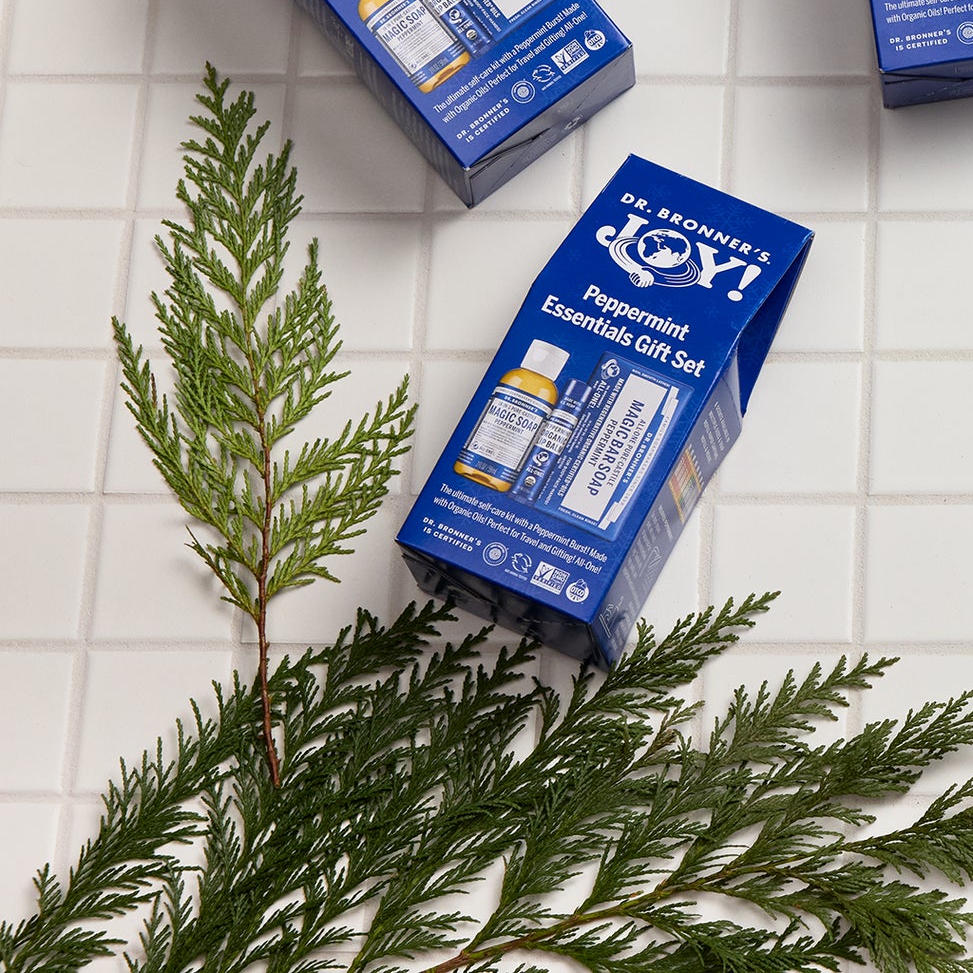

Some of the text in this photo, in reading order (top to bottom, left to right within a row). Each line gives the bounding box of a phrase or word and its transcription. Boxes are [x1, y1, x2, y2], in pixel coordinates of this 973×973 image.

[382, 5, 429, 42] MAGIC SOAP
[884, 2, 897, 10] The
[885, 13, 901, 23] with
[901, 10, 927, 22] Organic
[926, 7, 942, 17] Oils!
[942, 4, 967, 14] Perfect
[432, 102, 447, 112] The
[444, 84, 470, 105] ultimate
[467, 67, 493, 88] self-care
[489, 60, 501, 70] kit
[498, 51, 513, 64] with
[513, 24, 548, 52] Peppermint
[544, 12, 563, 29] Burst!
[561, 2, 580, 16] Made
[442, 10, 586, 122] with Organic Oils! Perfect for Travel and Gifting! All-One!
[618, 191, 650, 212] DR.
[595, 212, 762, 302] JOY!
[541, 294, 705, 377] Essentials Gift Set
[582, 283, 689, 341] Peppermint
[488, 405, 538, 434] MAGIC SOAP
[587, 399, 644, 495] MAGIC BAR SOAP
[433, 496, 601, 573] with Organic Oils! Perfect for Travel and Gifting! All-One!
[440, 483, 452, 495] The
[451, 490, 478, 506] ultimate
[477, 501, 505, 517] self-care
[504, 511, 515, 522] kit
[513, 516, 528, 528] with
[532, 523, 570, 546] Peppermint
[568, 539, 590, 554] Burst!
[588, 548, 607, 562] Made
